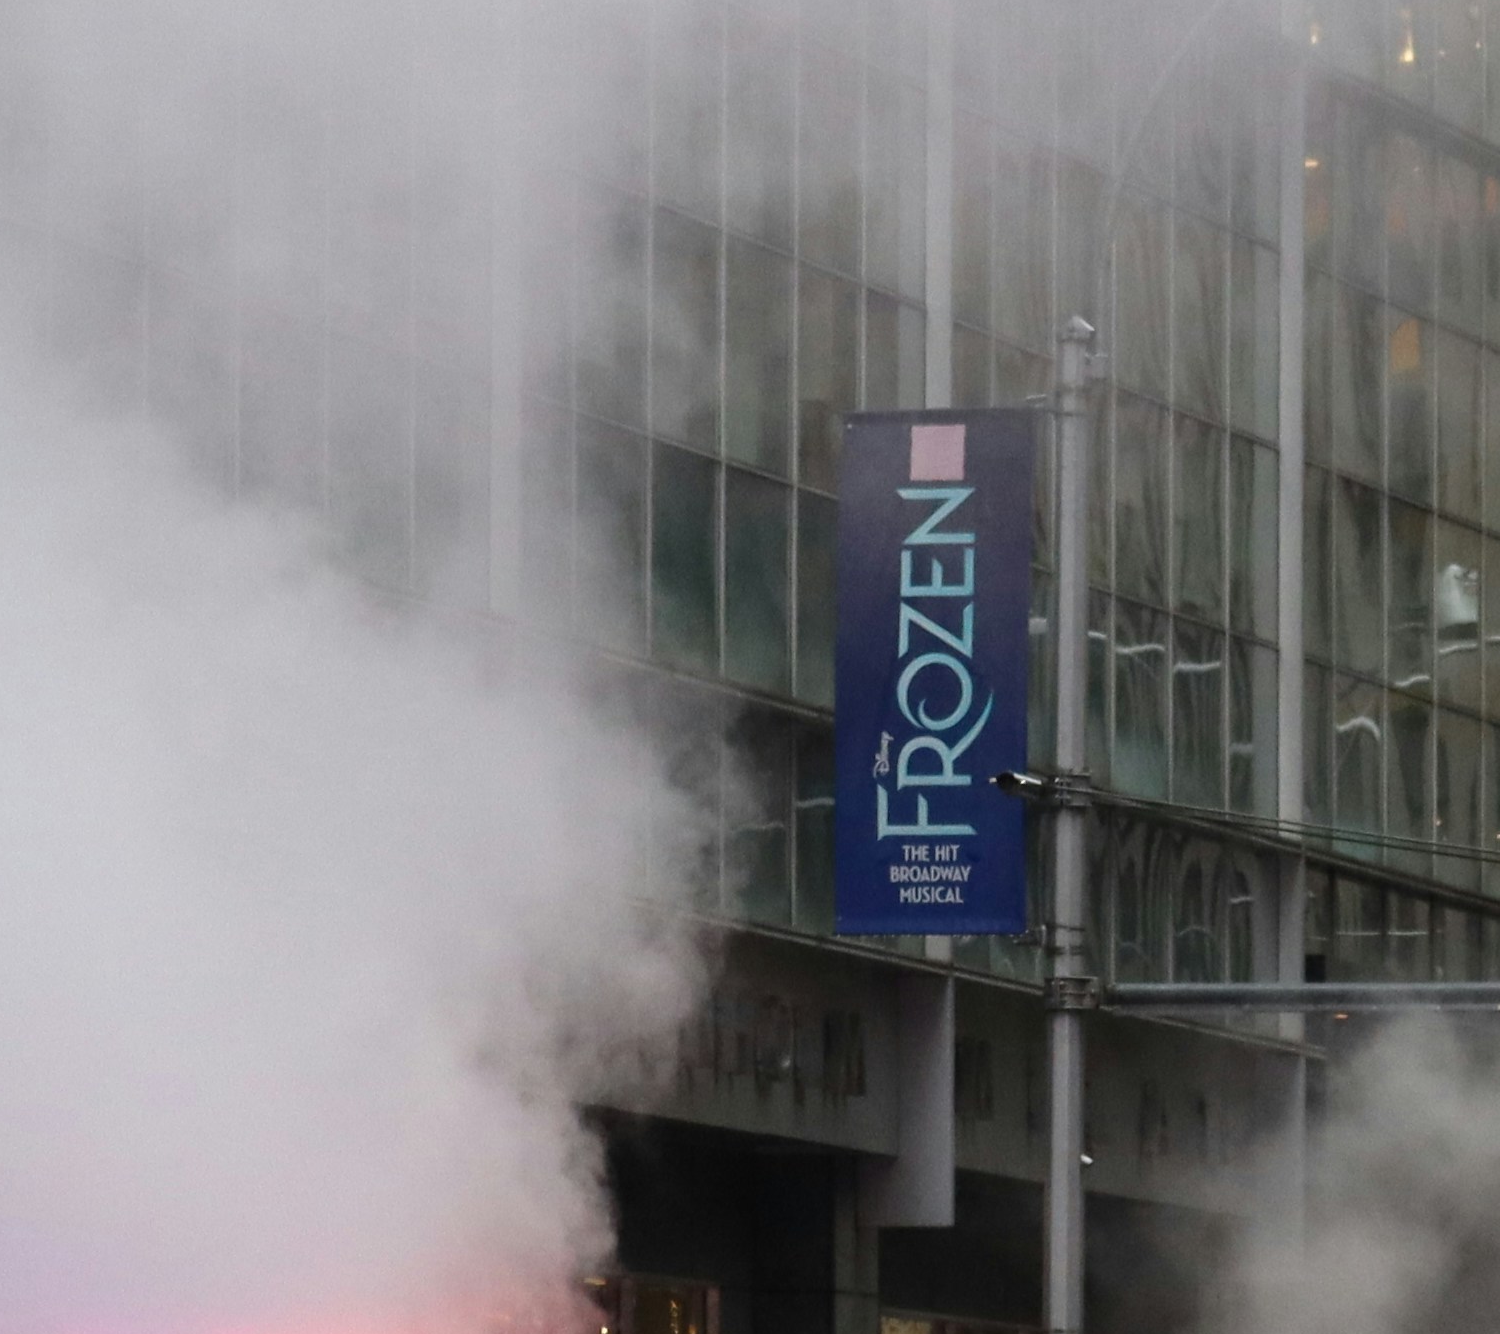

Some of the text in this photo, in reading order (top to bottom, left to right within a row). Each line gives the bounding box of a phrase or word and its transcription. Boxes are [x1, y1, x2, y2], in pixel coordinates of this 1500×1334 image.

[876, 487, 994, 841] FROZEN
[902, 844, 961, 862] THE HIT
[890, 864, 972, 884] BROADWAY
[899, 885, 964, 905] MUSICAL
